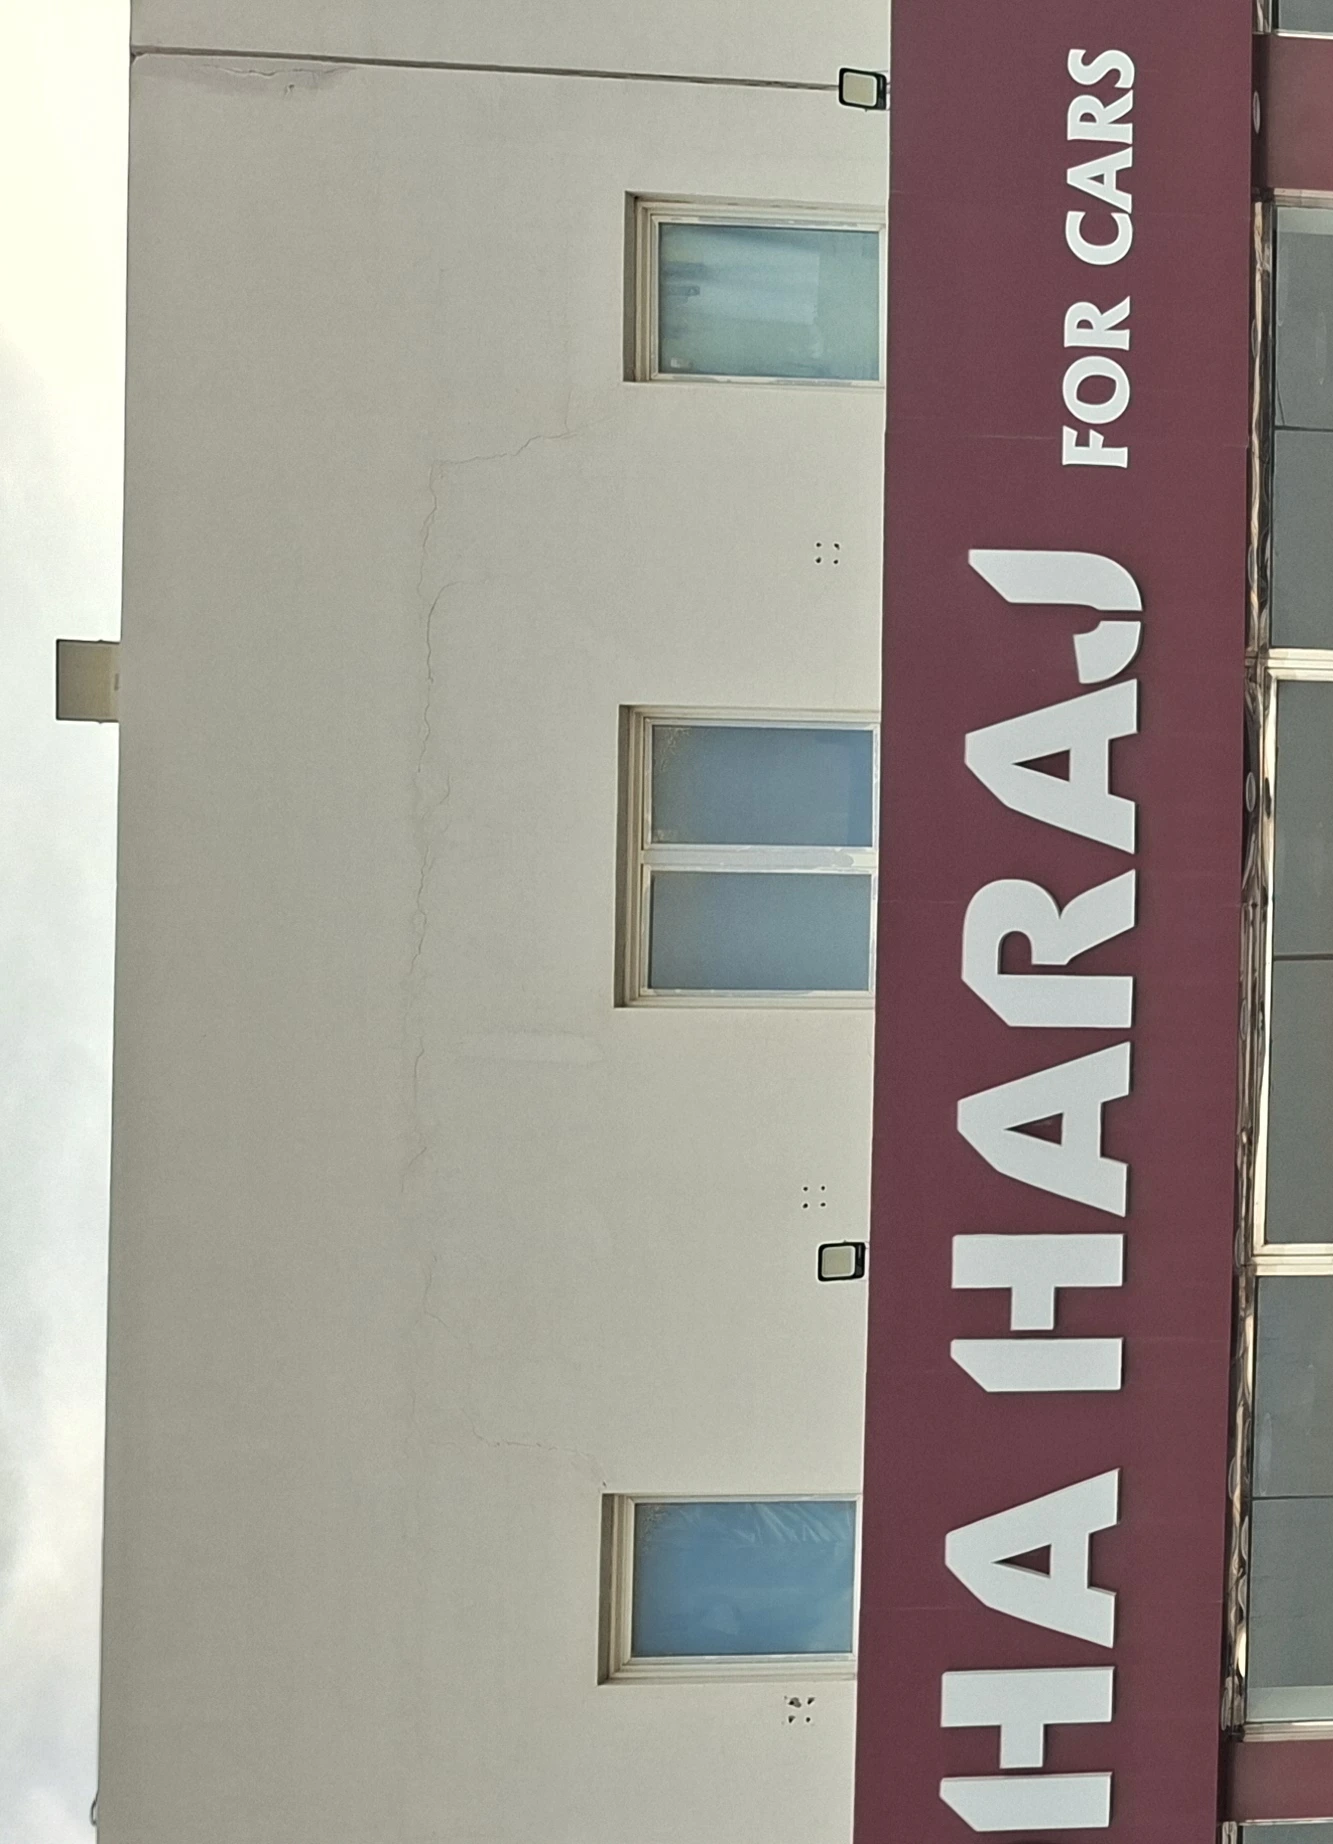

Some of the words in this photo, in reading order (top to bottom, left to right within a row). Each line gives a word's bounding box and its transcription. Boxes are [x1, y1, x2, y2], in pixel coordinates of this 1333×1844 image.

[1065, 47, 1138, 265] CARS
[1061, 297, 1134, 468] FOR
[948, 549, 1144, 1392] HARAJ
